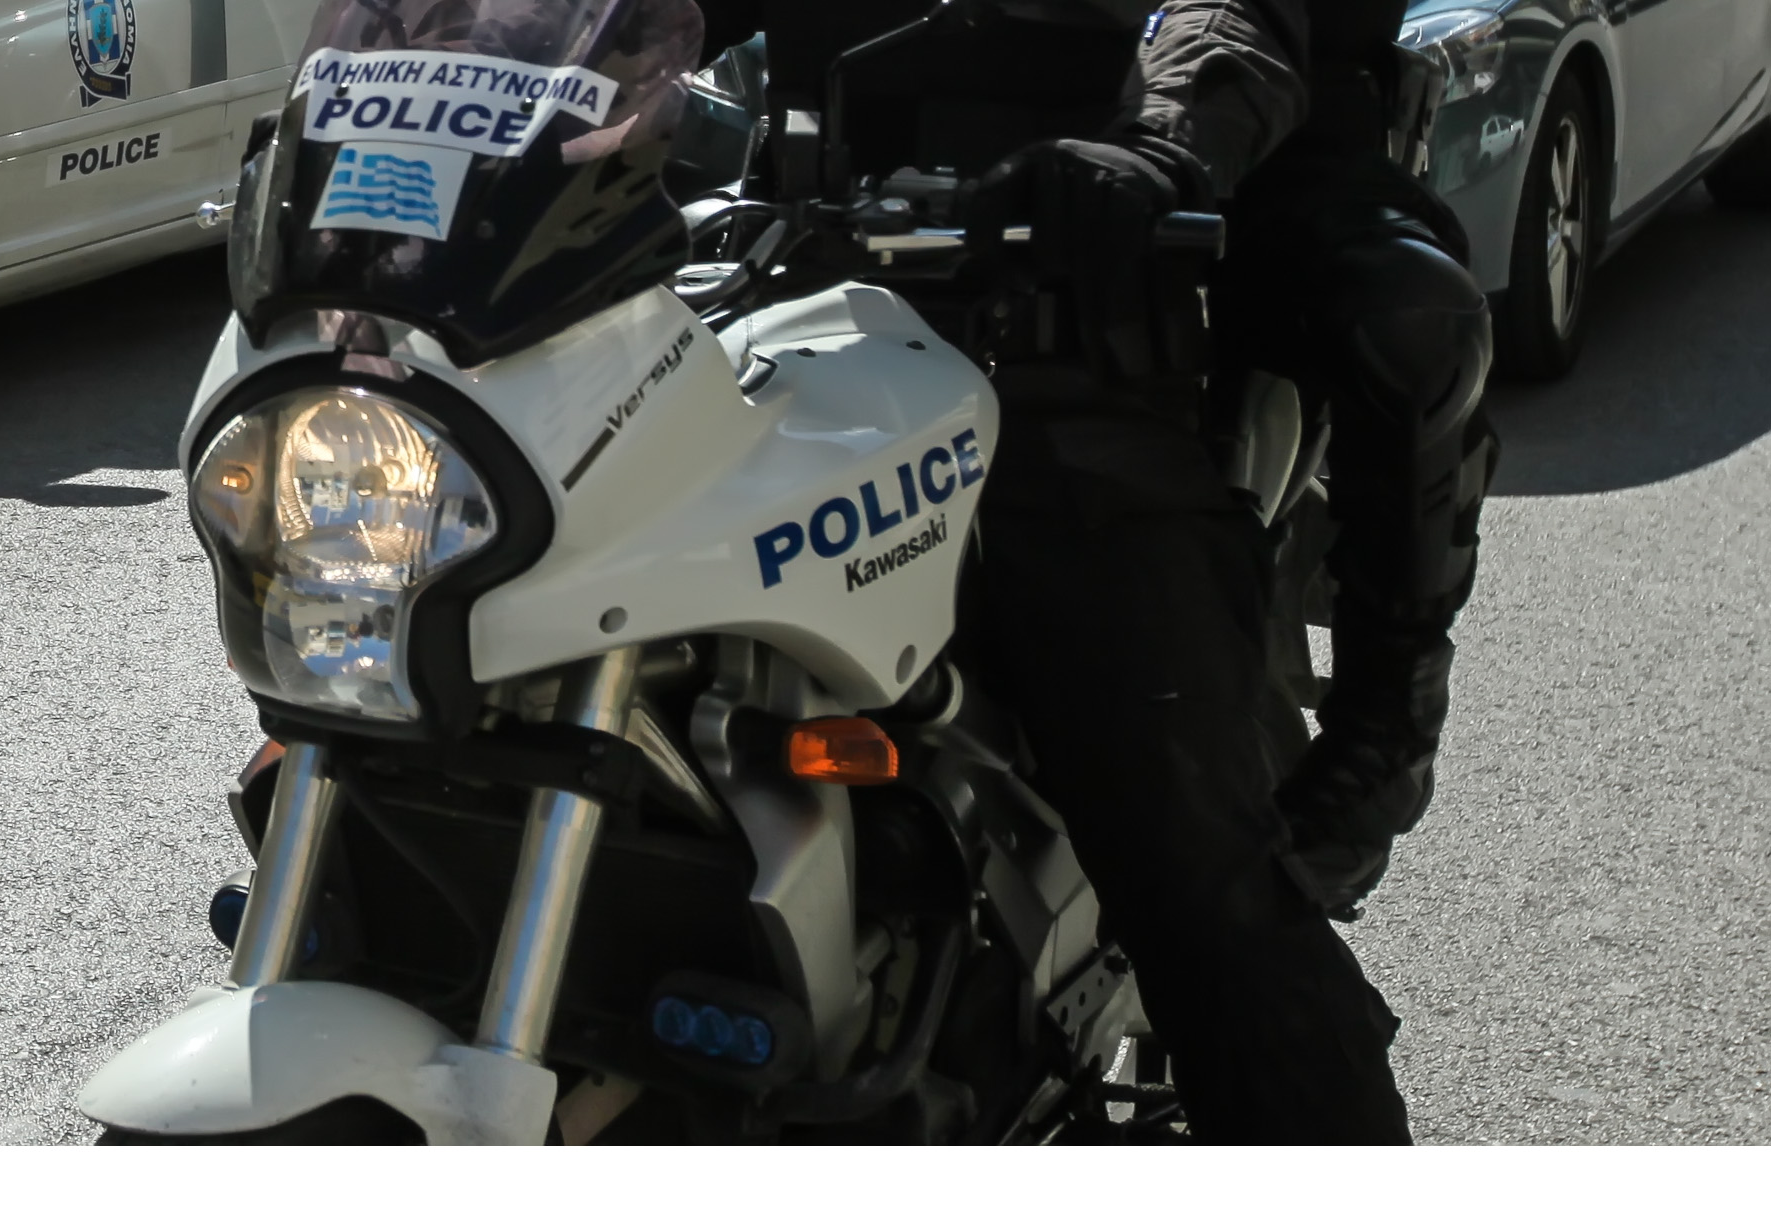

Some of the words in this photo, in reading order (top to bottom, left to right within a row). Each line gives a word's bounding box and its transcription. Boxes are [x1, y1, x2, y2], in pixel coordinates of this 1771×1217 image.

[59, 132, 161, 181] POLICE
[313, 95, 534, 145] POLICE
[606, 326, 695, 430] Versys
[753, 427, 986, 590] POLICE
[844, 512, 949, 593] Kawasaki
